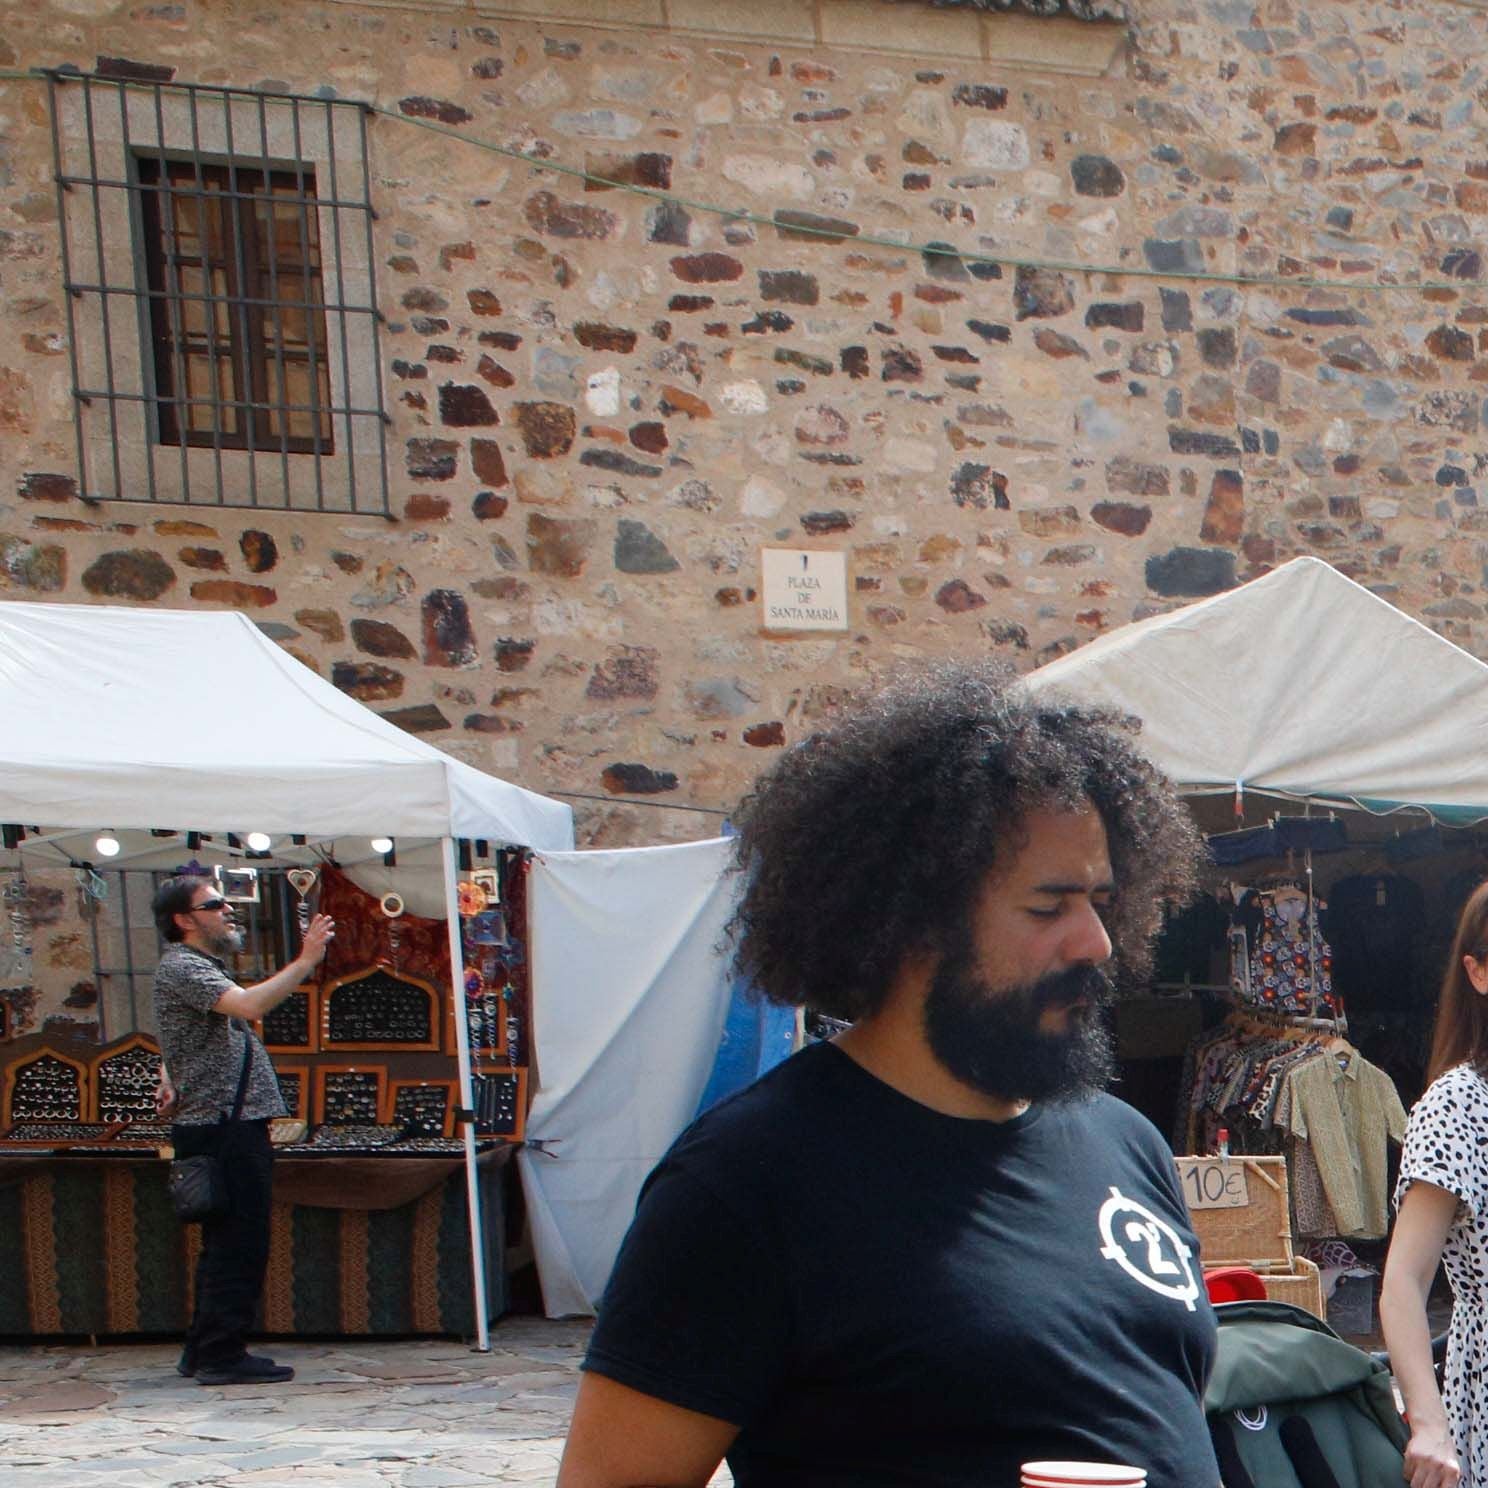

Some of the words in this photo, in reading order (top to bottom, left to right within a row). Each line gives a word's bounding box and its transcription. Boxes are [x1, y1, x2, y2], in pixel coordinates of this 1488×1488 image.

[787, 576, 821, 589] PLAZA
[798, 592, 812, 603] DE
[769, 607, 803, 619] SANTA
[805, 607, 840, 621] MARÍA
[1186, 1166, 1242, 1203] 10€
